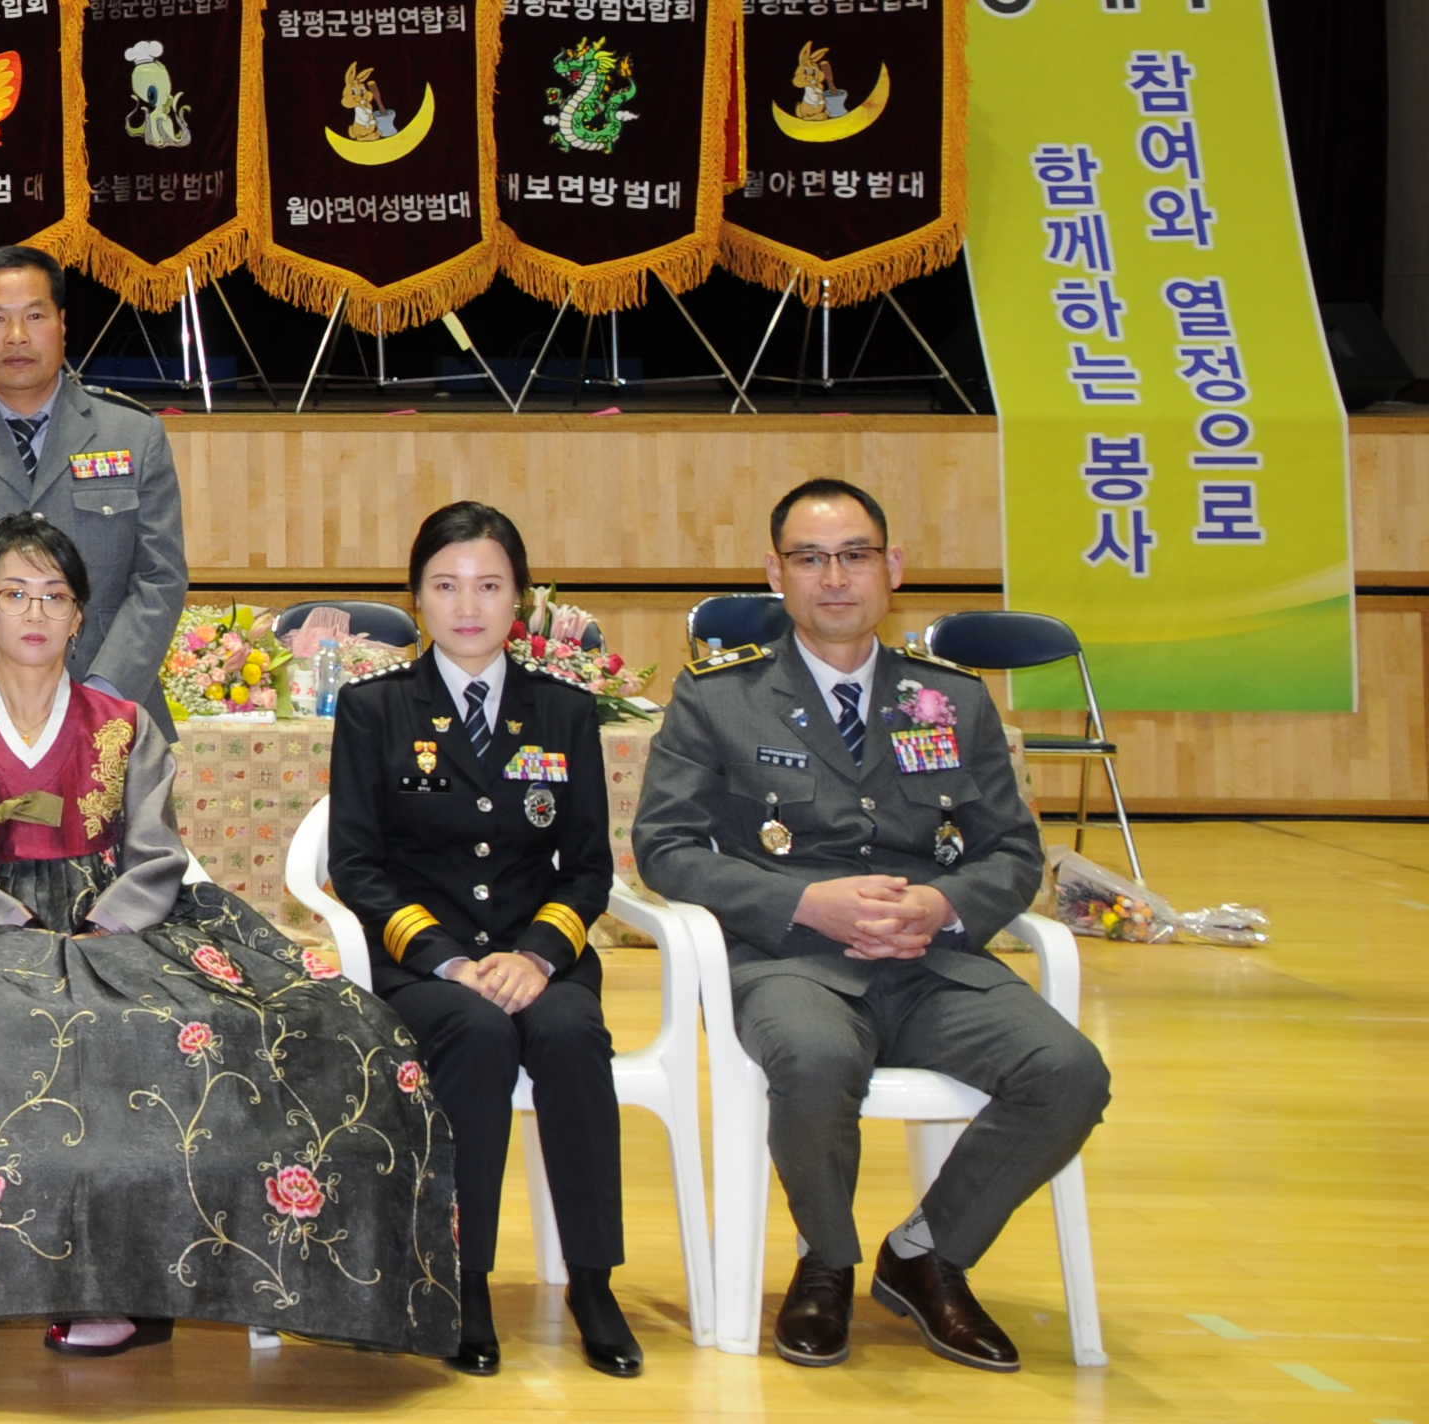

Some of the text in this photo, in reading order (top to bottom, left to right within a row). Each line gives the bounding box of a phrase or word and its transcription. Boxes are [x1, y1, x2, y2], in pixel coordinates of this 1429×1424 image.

[277, 5, 467, 39] 함평군방범연합회
[91, 169, 224, 203] 손불면방범대
[500, 173, 682, 209] 해보면방범대
[285, 191, 472, 226] 월야면여성방범대
[1128, 53, 1262, 542] 참여와 열정으로
[1032, 145, 1154, 574] 함께하는 봉사
